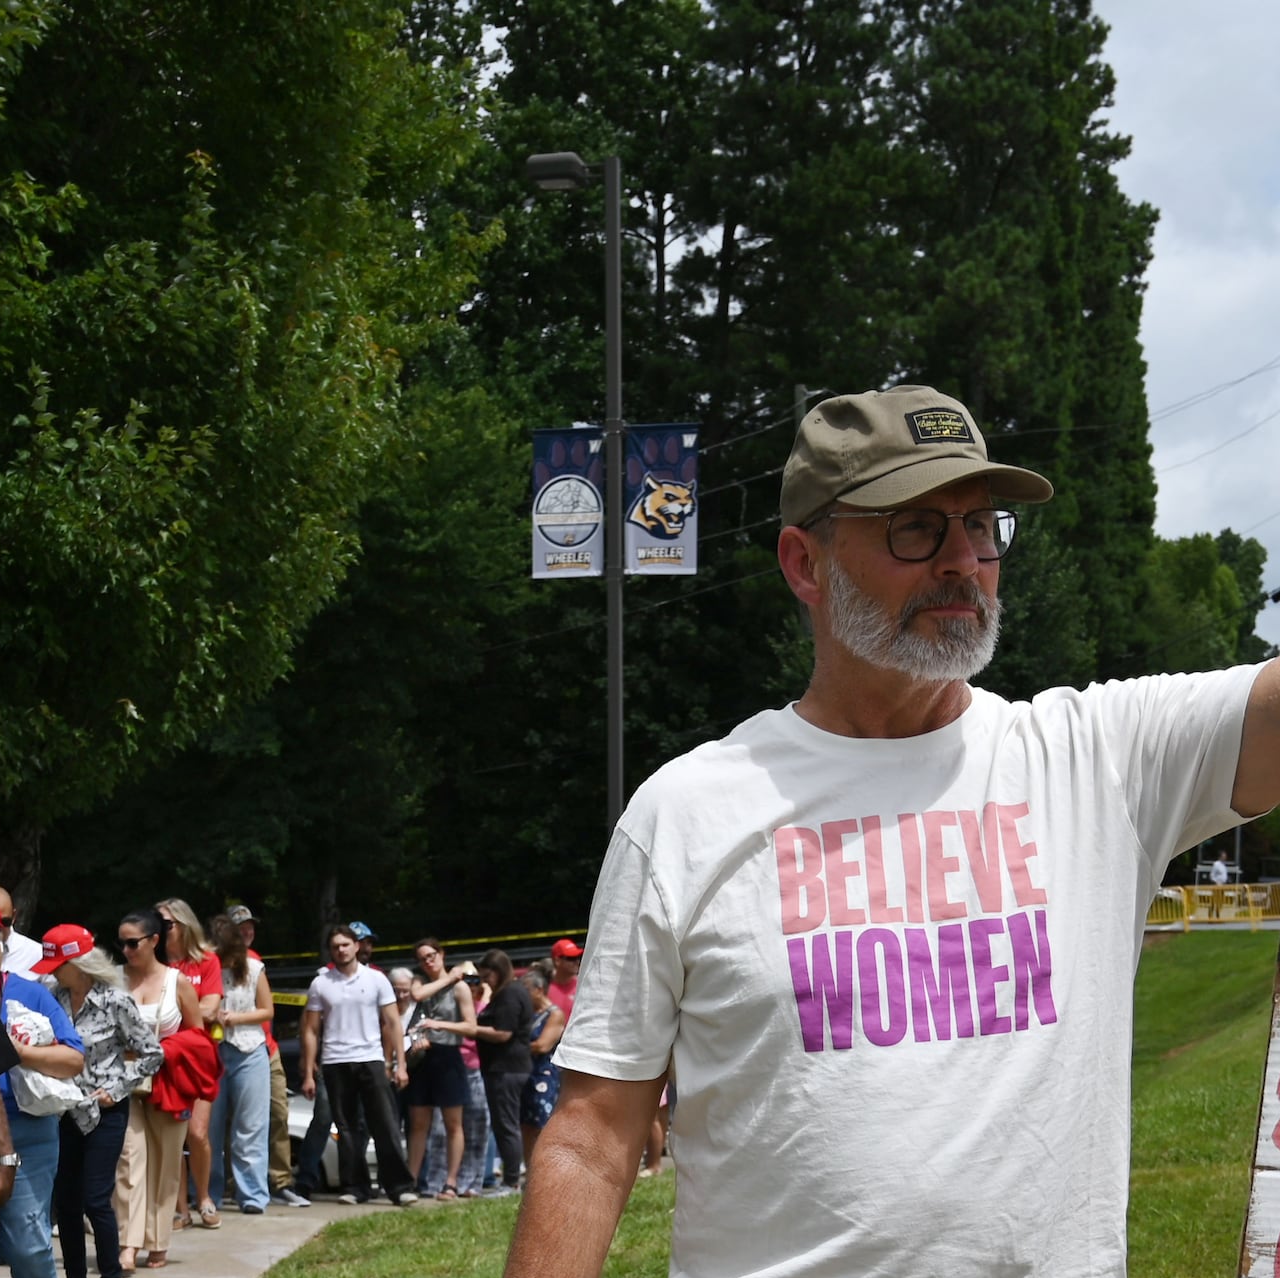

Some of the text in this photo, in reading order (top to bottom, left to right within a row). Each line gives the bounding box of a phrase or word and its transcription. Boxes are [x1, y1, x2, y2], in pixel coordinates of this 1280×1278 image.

[682, 434, 698, 448] W
[546, 552, 591, 564] WHEELER
[638, 547, 683, 559] WHEELER
[773, 801, 1047, 934] BELIEVE
[787, 909, 1057, 1053] WOMEN
